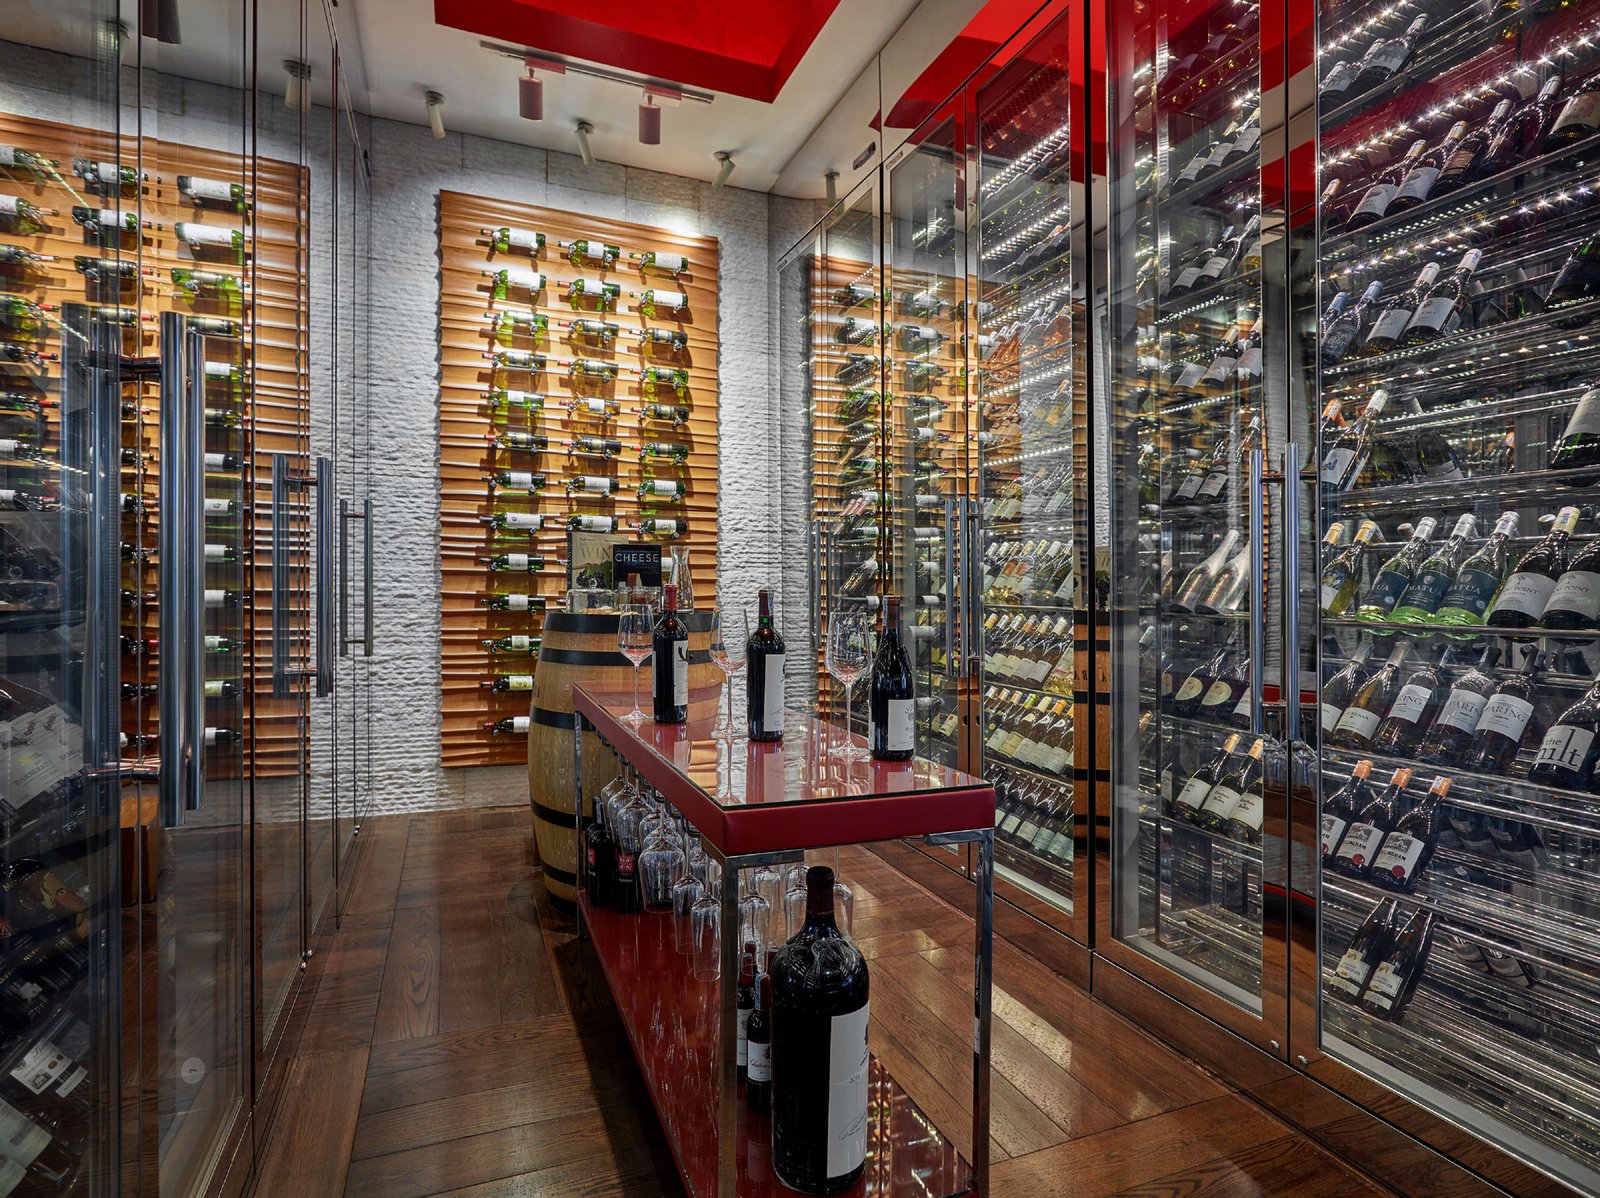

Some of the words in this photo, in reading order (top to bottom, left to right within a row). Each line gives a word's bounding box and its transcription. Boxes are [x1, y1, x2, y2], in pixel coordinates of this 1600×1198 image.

[581, 546, 613, 560] WIN
[614, 553, 659, 562] CHEESE
[1485, 705, 1526, 722] PARING
[1545, 737, 1562, 745] the
